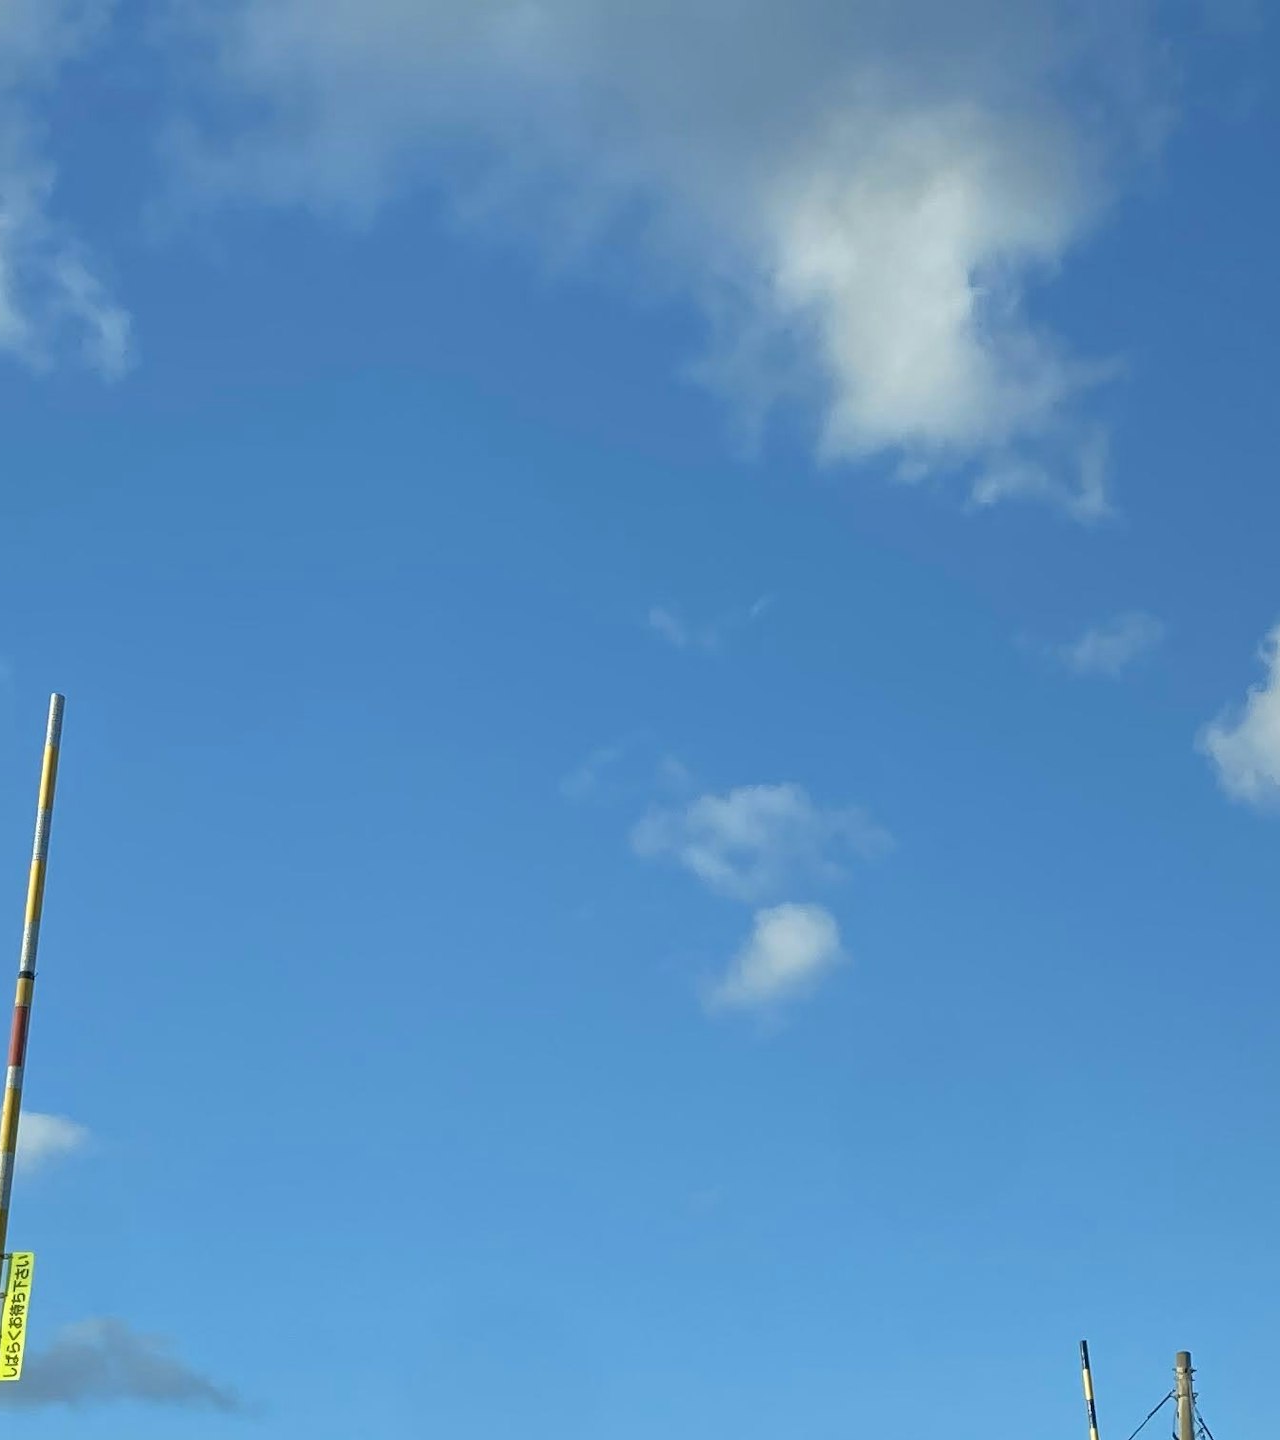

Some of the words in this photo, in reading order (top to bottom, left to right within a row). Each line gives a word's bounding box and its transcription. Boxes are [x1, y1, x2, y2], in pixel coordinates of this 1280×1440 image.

[3, 1254, 29, 1378] しばらくお待ち下さい
